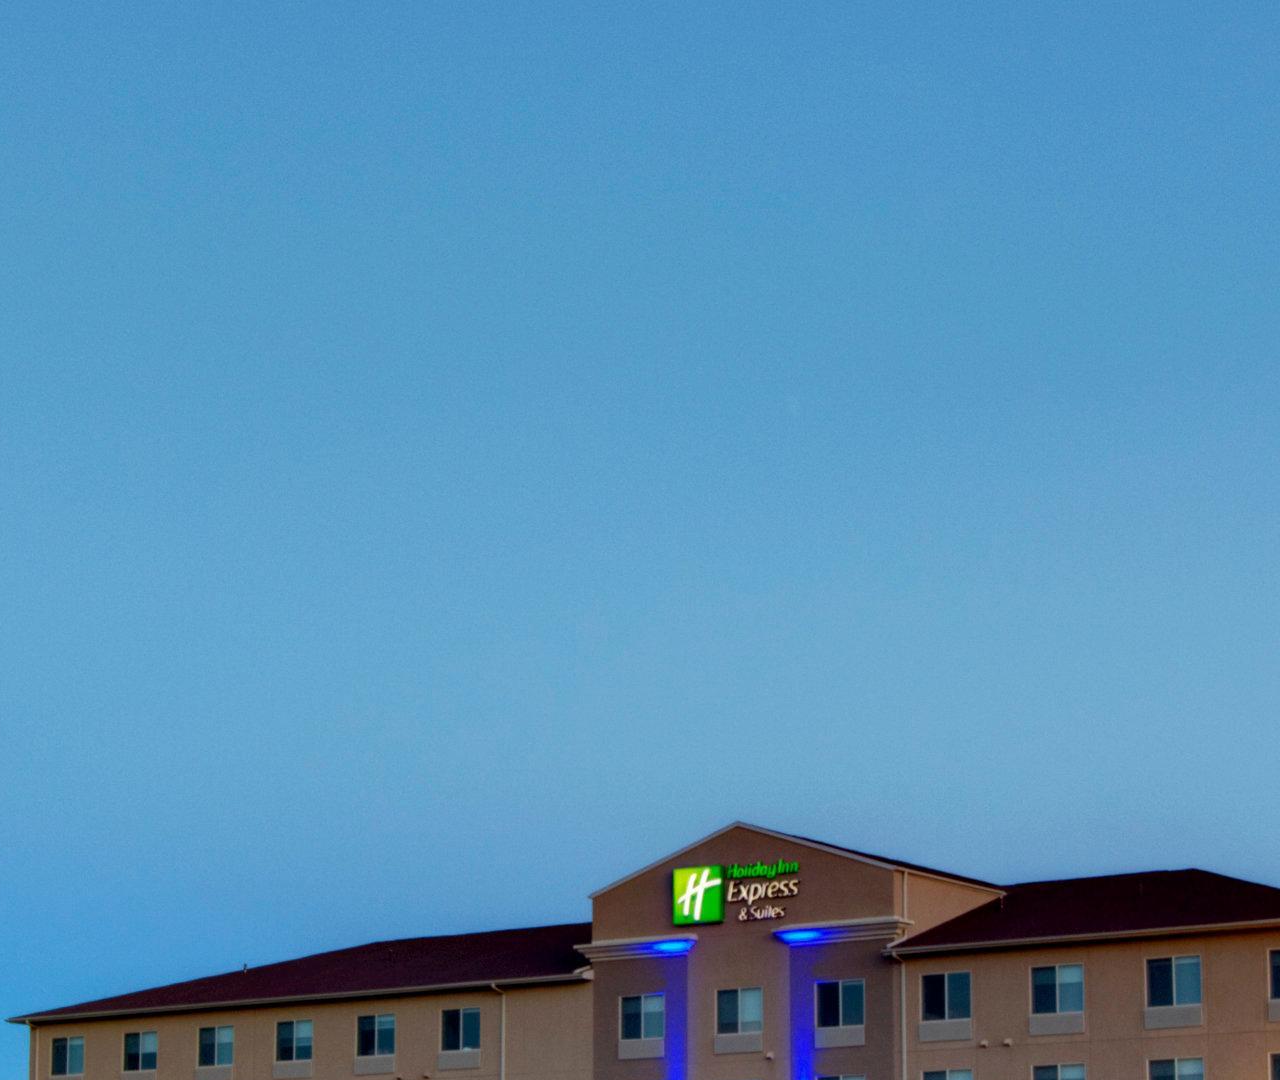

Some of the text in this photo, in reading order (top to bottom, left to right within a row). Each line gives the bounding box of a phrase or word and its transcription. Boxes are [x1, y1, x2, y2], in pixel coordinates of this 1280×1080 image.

[727, 859, 799, 879] Holiday Inn
[727, 879, 799, 905] Express
[738, 905, 785, 921] & Suites
